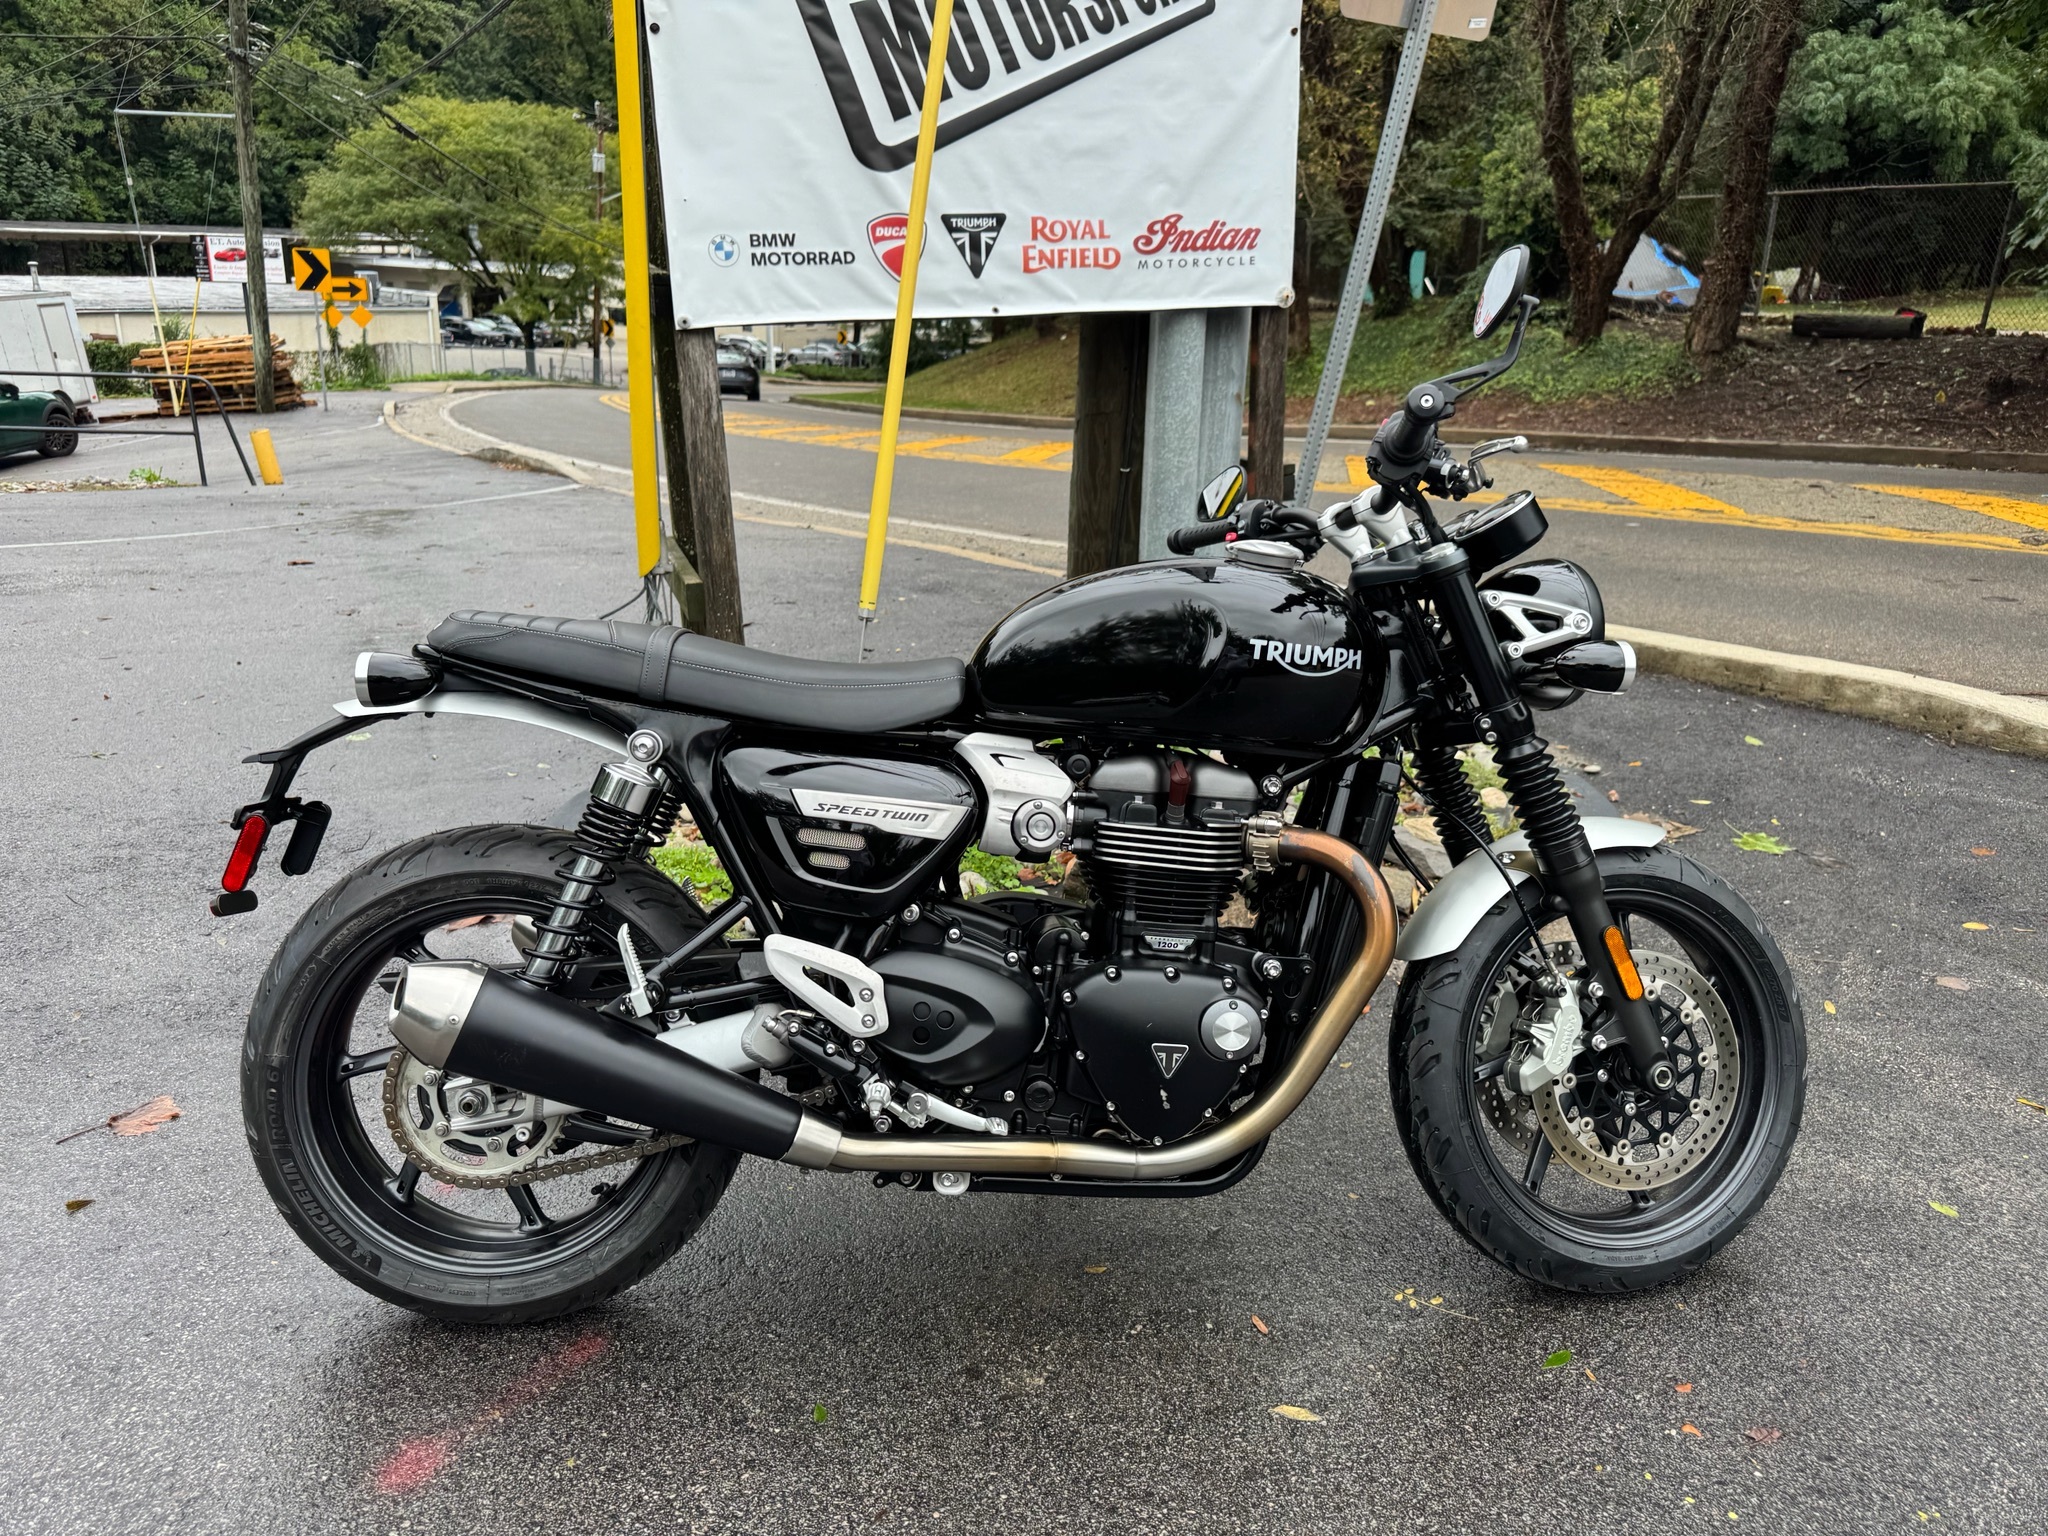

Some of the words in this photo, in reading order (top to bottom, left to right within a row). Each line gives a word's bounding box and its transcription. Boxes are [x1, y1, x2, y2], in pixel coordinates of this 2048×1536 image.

[875, 226, 908, 237] DUCA
[950, 217, 997, 231] TRIUMPH
[1031, 216, 1111, 243] ROYAL
[226, 238, 245, 246] Auto
[750, 233, 796, 248] BMW
[1133, 214, 1262, 256] Indian
[751, 251, 856, 266] MOTORRAD
[1022, 245, 1122, 274] ENFIELD
[1137, 256, 1257, 270] MOTORCYCLE
[1249, 638, 1362, 677] TRIUMPH
[813, 802, 880, 818] SPEED
[881, 809, 930, 823] TWIN
[1157, 941, 1179, 949] 1200
[266, 1069, 280, 1083] 6
[266, 1087, 287, 1141] ROAD
[280, 1158, 350, 1249] MICHELIN
